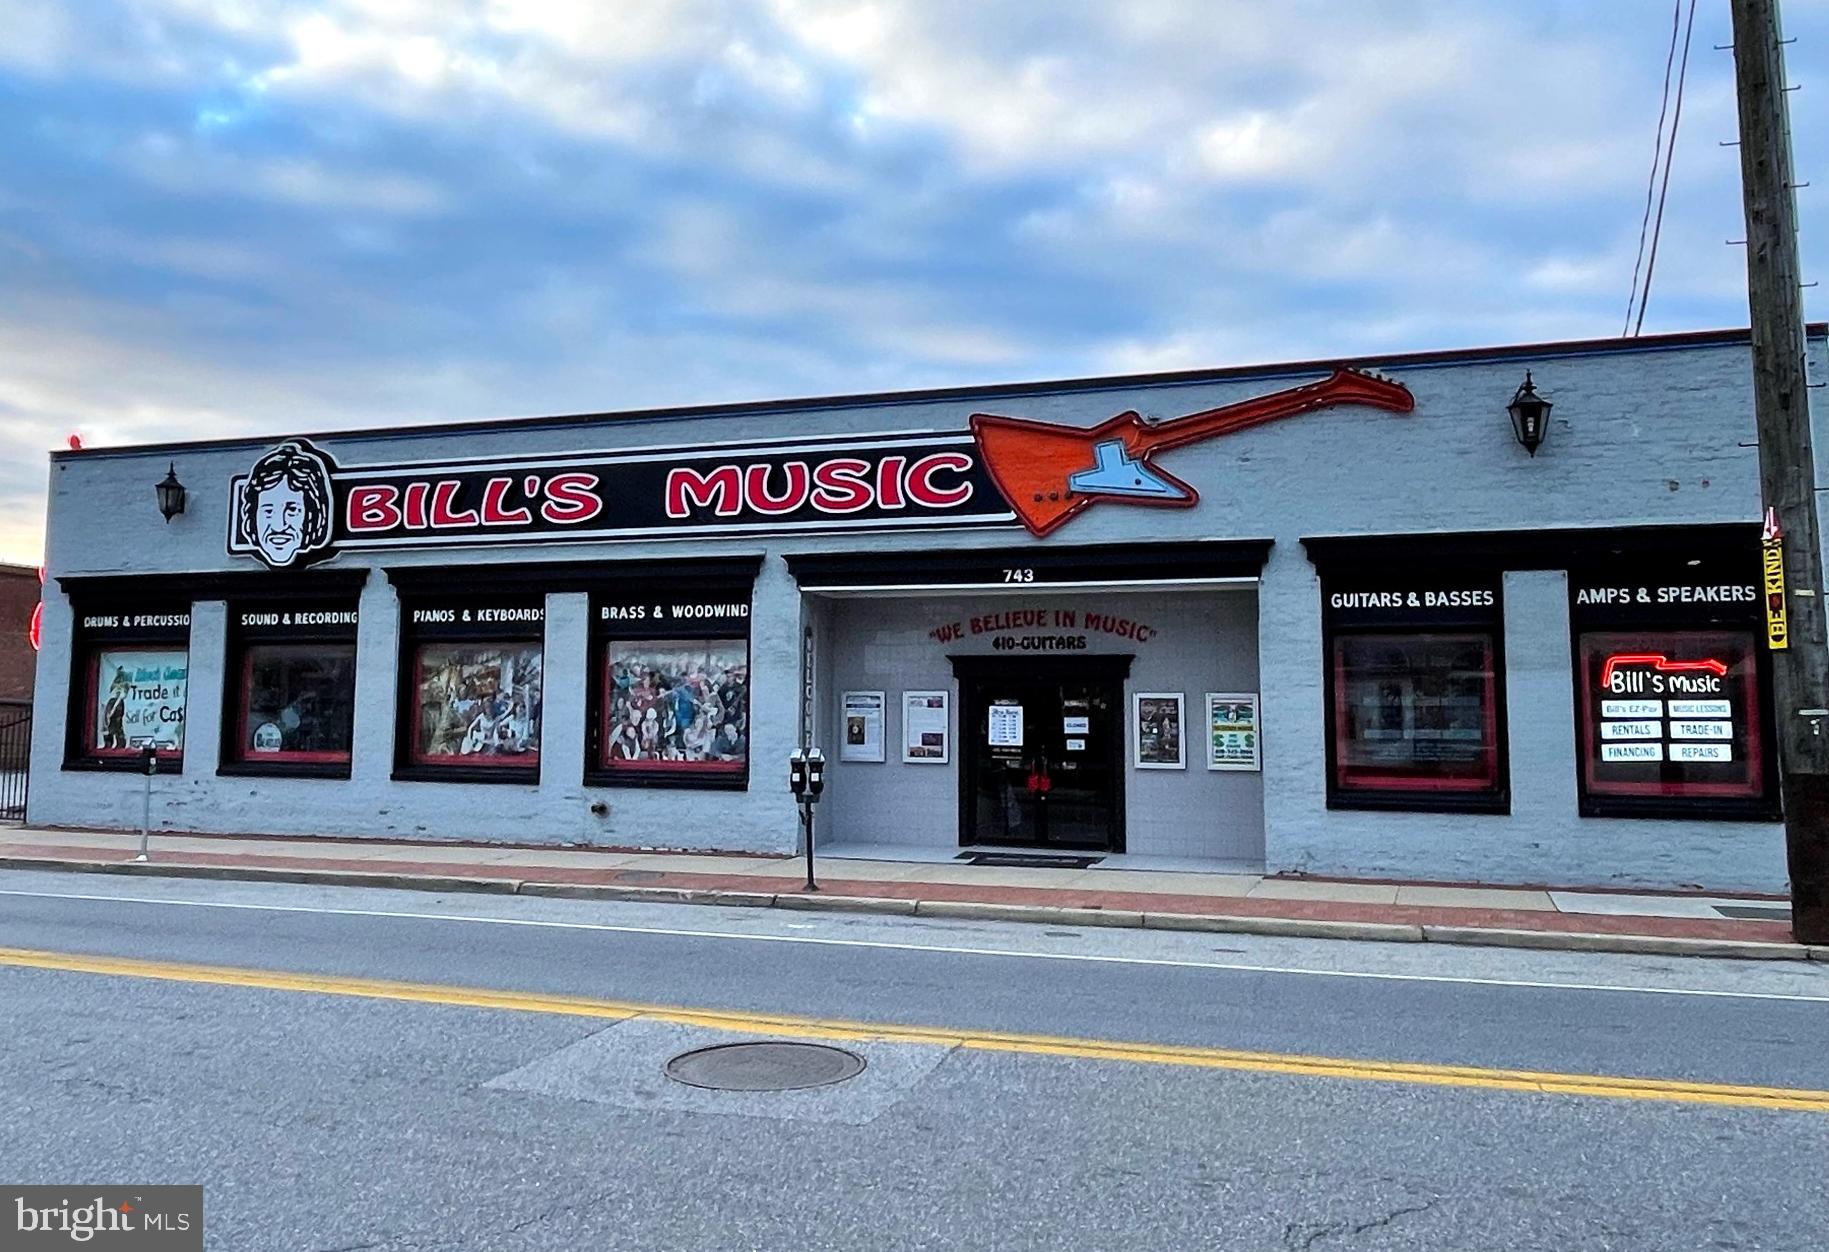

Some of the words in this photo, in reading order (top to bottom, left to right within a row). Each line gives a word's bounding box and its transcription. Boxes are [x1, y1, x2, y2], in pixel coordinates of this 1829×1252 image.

[347, 473, 602, 532] BILL'S
[665, 453, 973, 517] MUSIC
[1003, 568, 1033, 582] 743
[1764, 548, 1782, 595] KIND
[1331, 592, 1403, 608] GUITARS
[1406, 591, 1421, 607] &
[1425, 590, 1494, 606] BASSES
[1577, 588, 1630, 604] AMPS
[1636, 587, 1651, 603] &
[1657, 586, 1756, 603] SPEAKERS
[241, 613, 279, 625] SOUND
[282, 612, 291, 625] &
[294, 611, 358, 624] RECORDING
[413, 609, 455, 623] PIANOS
[462, 609, 471, 621] &
[601, 605, 646, 619] BRASS
[653, 605, 663, 618] &
[672, 604, 749, 618] WOODWIND
[84, 615, 119, 628] DRUMS
[122, 615, 131, 627] &
[969, 609, 1047, 635] BELIEVE
[1055, 610, 1076, 628] IN
[992, 635, 1087, 651] 410-GUITARS
[1610, 671, 1664, 693] Bill's
[1668, 674, 1721, 693] Music
[131, 684, 168, 700] Trade
[1612, 725, 1651, 735] RENTALS
[1680, 725, 1723, 735] TRADE-IN
[1608, 747, 1656, 758] FINANCING
[1681, 747, 1719, 758] REPAIRS
